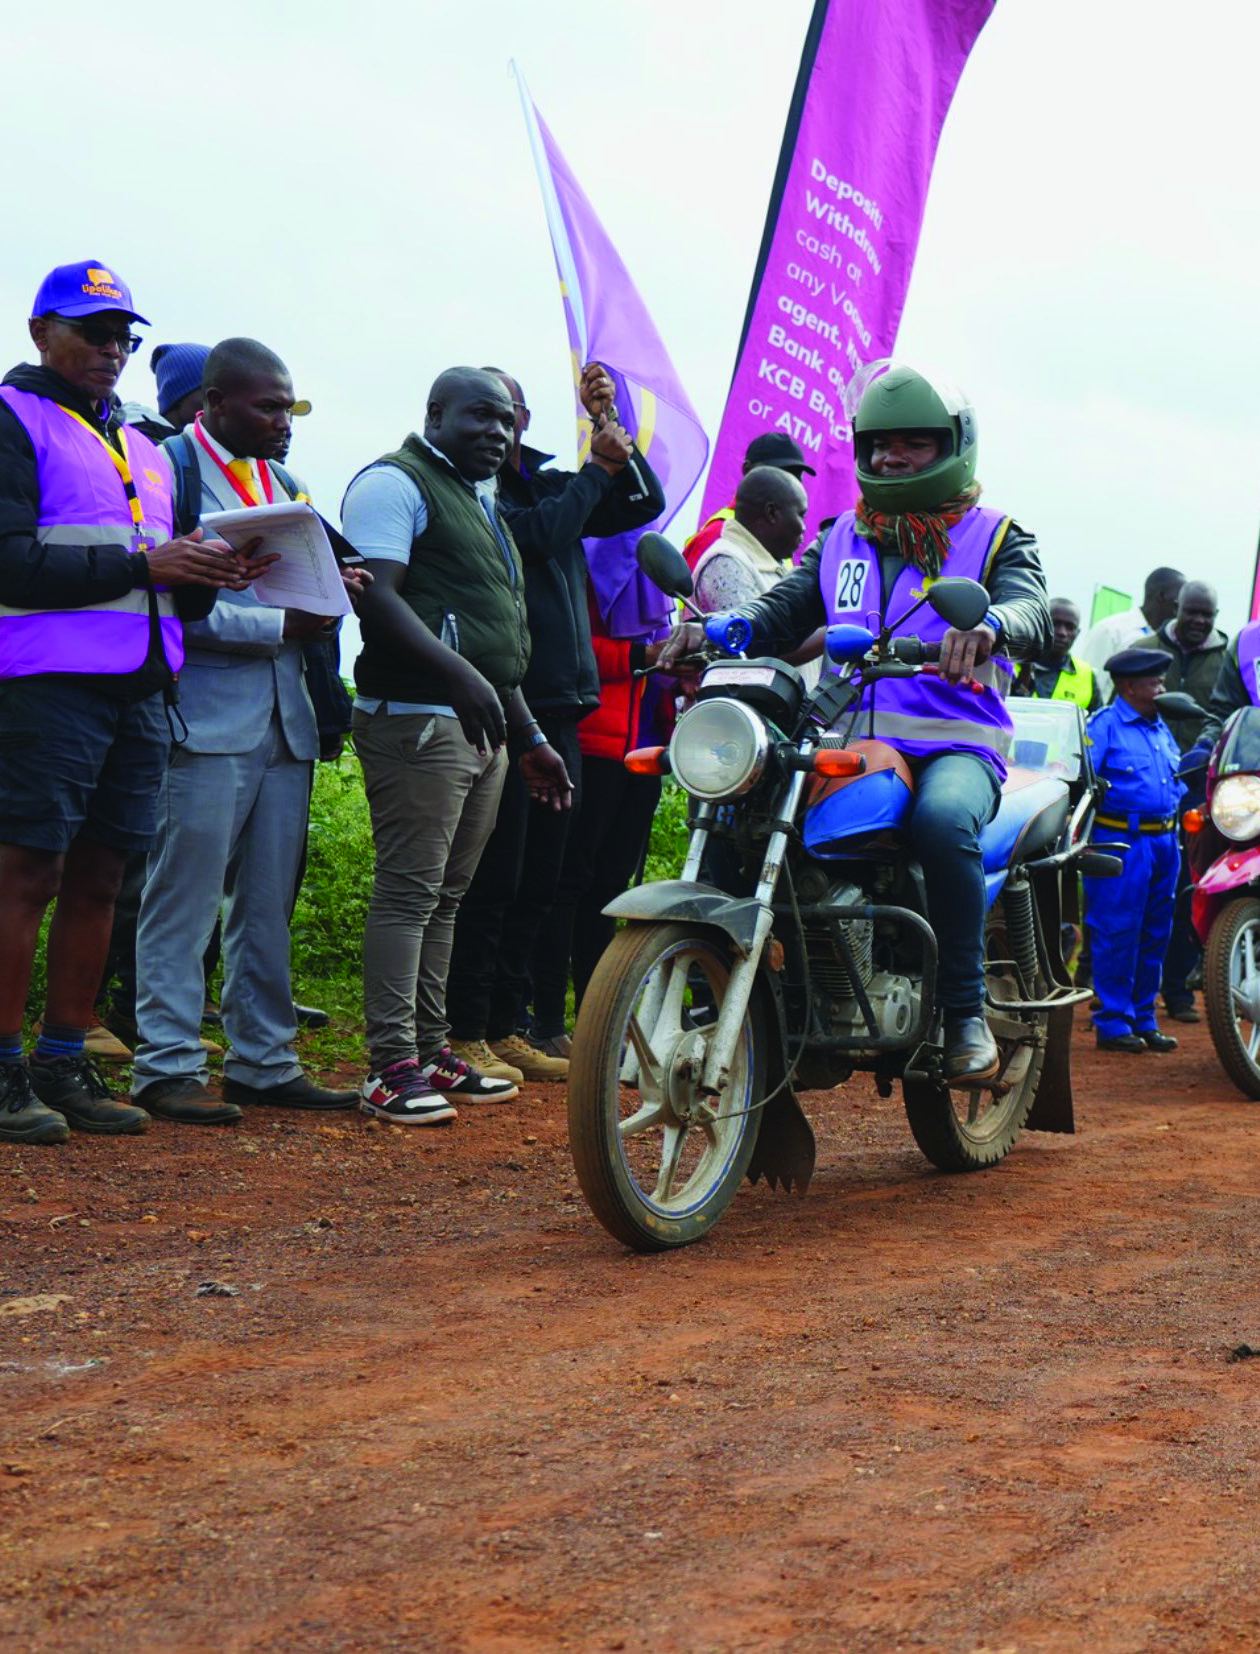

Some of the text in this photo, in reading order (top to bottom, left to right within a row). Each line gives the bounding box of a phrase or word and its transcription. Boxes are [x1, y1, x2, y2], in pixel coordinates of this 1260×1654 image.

[796, 229, 842, 269] cash
[806, 190, 881, 276] Withdraw
[786, 262, 825, 296] any
[777, 295, 842, 350] agent,
[768, 324, 825, 374] Bank
[758, 357, 806, 400] KCB
[748, 399, 823, 453] or ATM
[838, 561, 865, 608] 28
